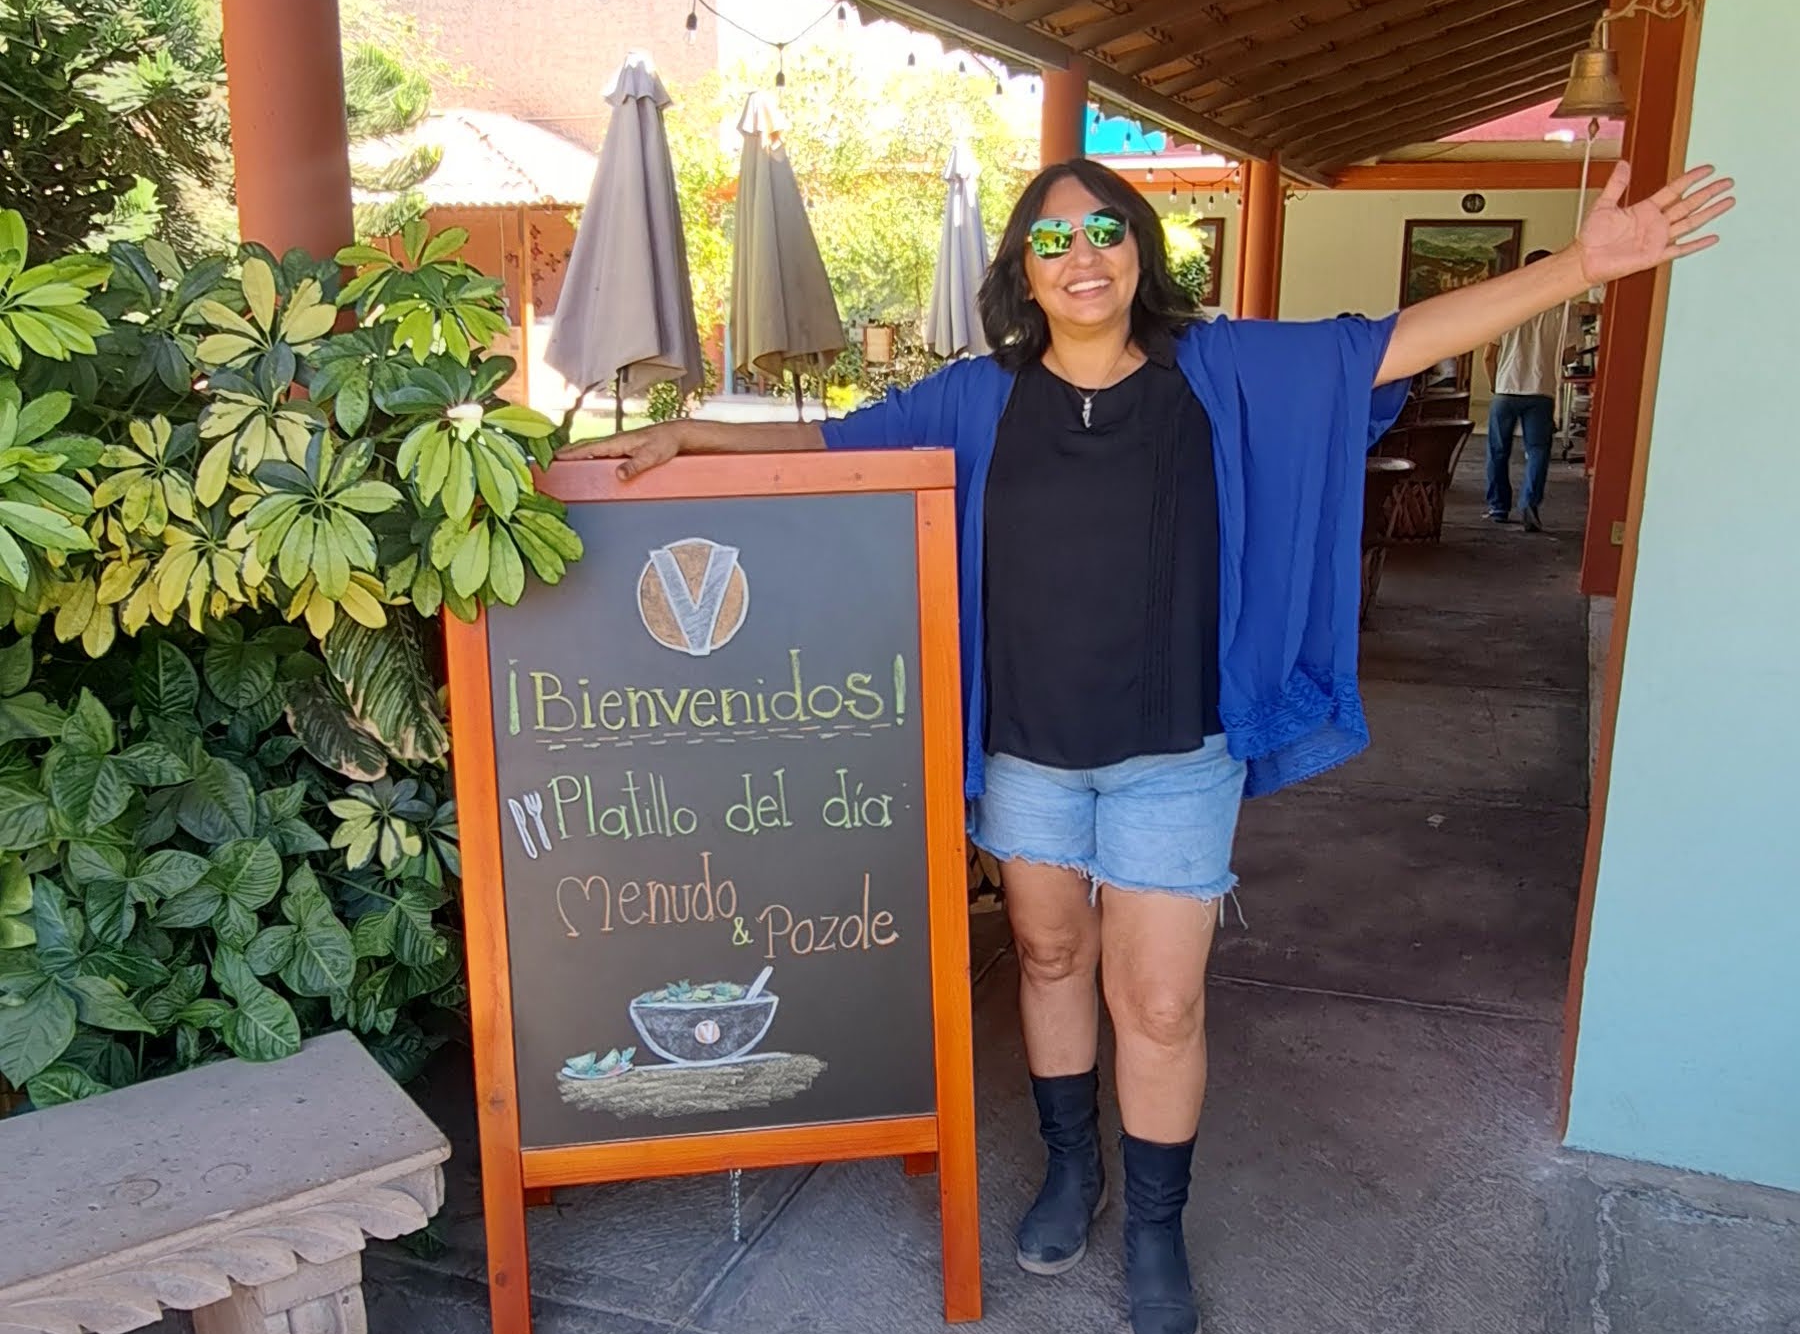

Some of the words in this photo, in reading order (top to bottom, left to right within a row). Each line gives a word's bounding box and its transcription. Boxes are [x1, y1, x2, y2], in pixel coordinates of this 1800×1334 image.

[649, 547, 740, 656] V
[508, 649, 906, 736] ¡Bienvenidos!
[547, 770, 698, 840] Platillo
[725, 768, 794, 835] del
[556, 851, 737, 937] Menudo
[732, 916, 755, 946] &
[755, 873, 899, 958] Pozole
